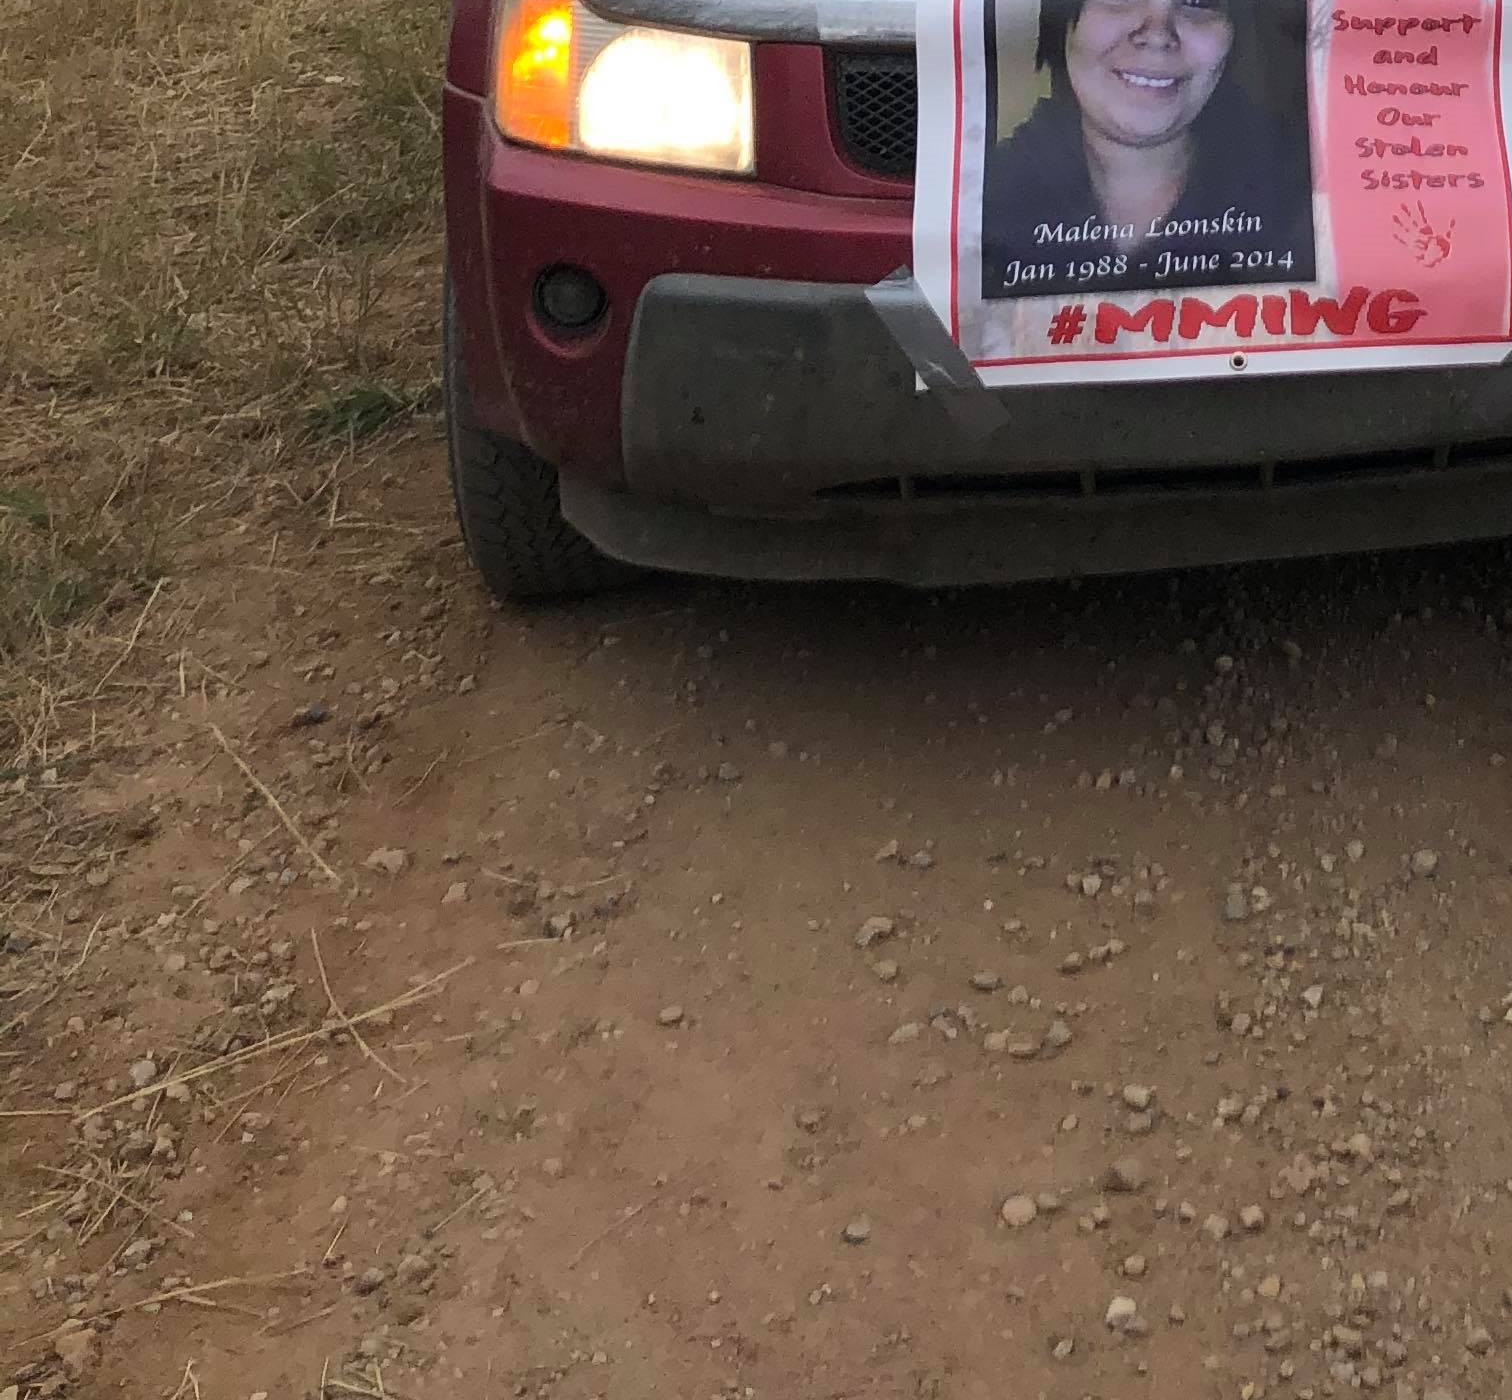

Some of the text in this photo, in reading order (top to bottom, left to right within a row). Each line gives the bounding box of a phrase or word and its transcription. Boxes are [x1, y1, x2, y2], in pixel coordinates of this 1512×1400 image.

[1331, 9, 1482, 36] Support
[1373, 45, 1438, 66] and
[1344, 73, 1470, 97] Honour
[1376, 107, 1441, 127] Our
[1354, 136, 1469, 159] Stolen
[1360, 168, 1485, 190] Sisters
[1033, 206, 1263, 244] Malena Loonskin
[1003, 259, 1056, 287] Jan
[1065, 254, 1129, 281] 1988
[1154, 251, 1220, 279] June
[1229, 250, 1294, 270] 2014
[1046, 286, 1429, 345] #MMIWG
